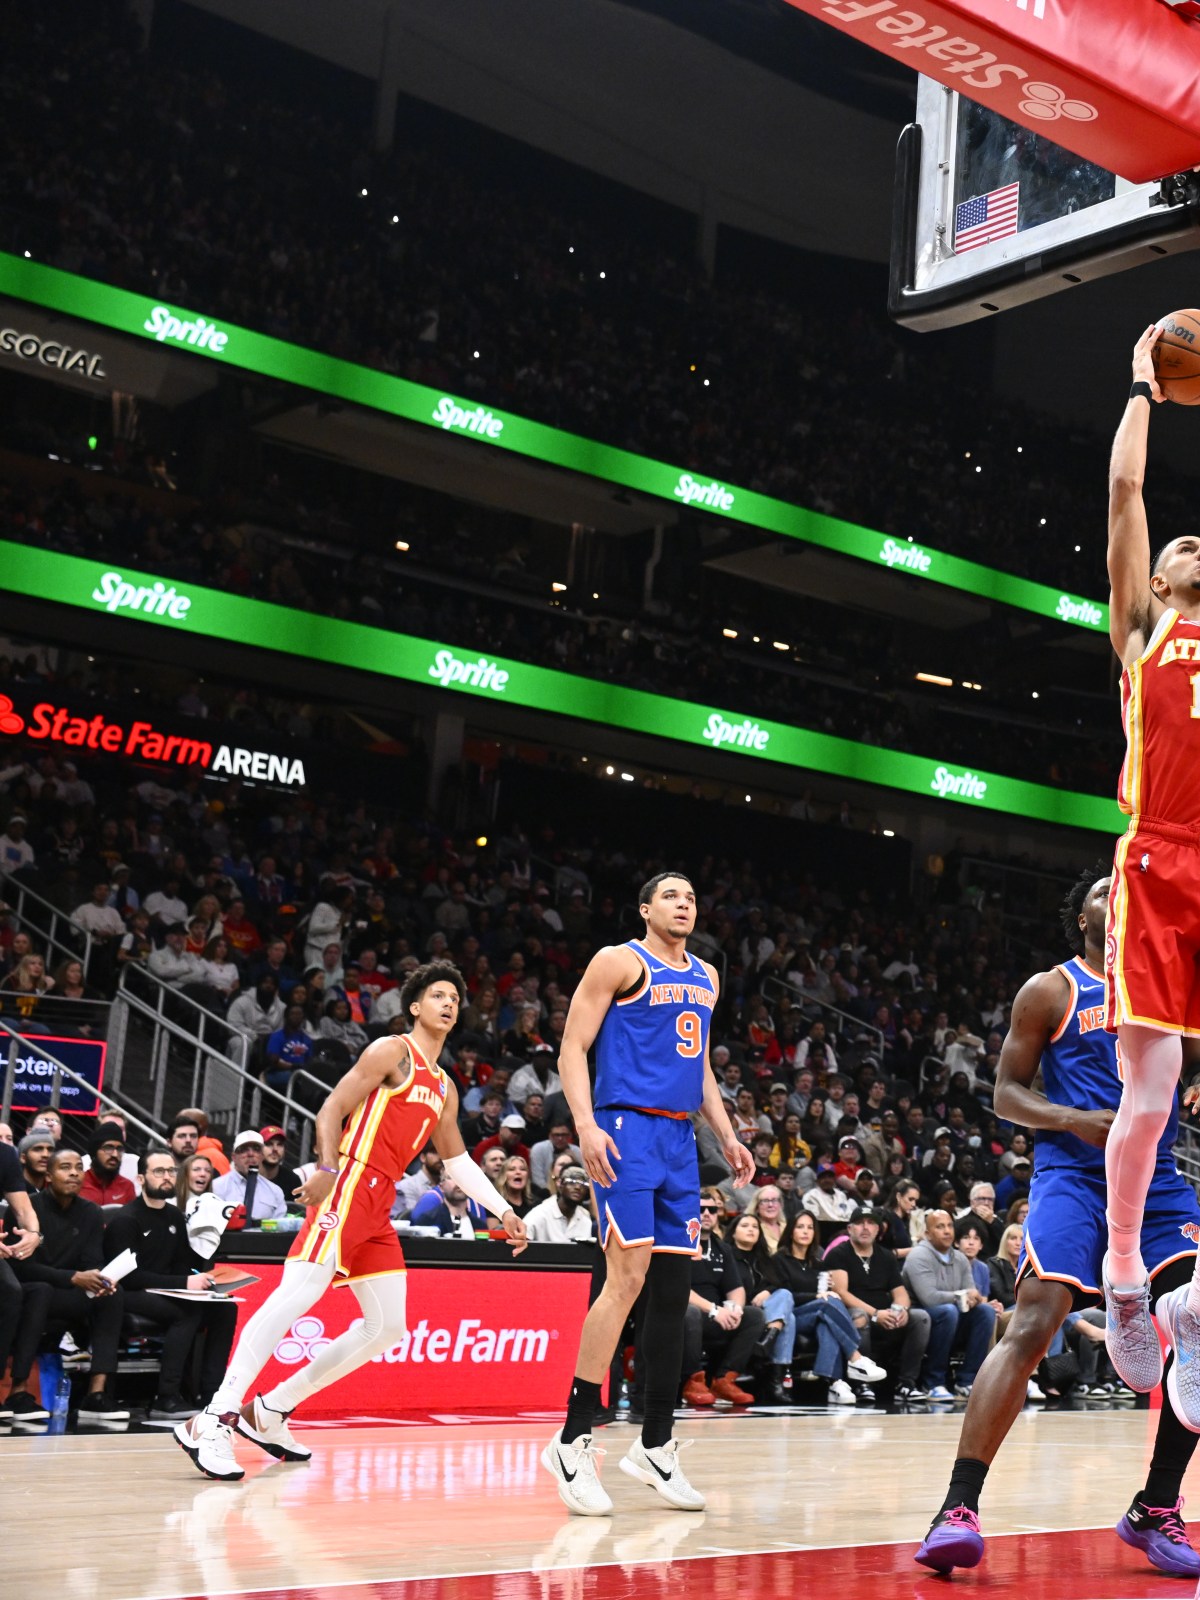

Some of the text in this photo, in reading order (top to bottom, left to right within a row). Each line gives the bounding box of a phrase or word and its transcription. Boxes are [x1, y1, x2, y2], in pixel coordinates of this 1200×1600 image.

[821, 0, 1029, 89] StateF
[143, 306, 229, 353] Sprite
[0, 328, 106, 379] SOCIAL
[431, 397, 504, 438] Sprite
[673, 474, 735, 511] Sprite
[879, 536, 932, 572] Sprite
[91, 572, 192, 620] Sprite
[1055, 595, 1103, 626] Sprite
[428, 649, 510, 692] Sprite
[702, 713, 770, 751] Sprite
[212, 745, 306, 786] ARENA
[930, 766, 987, 800] Sprite
[649, 984, 684, 1007] NEW
[676, 1011, 702, 1058] 9
[1077, 1004, 1105, 1035] NE
[411, 1117, 431, 1150] 1
[371, 1318, 549, 1363] ateFarm
